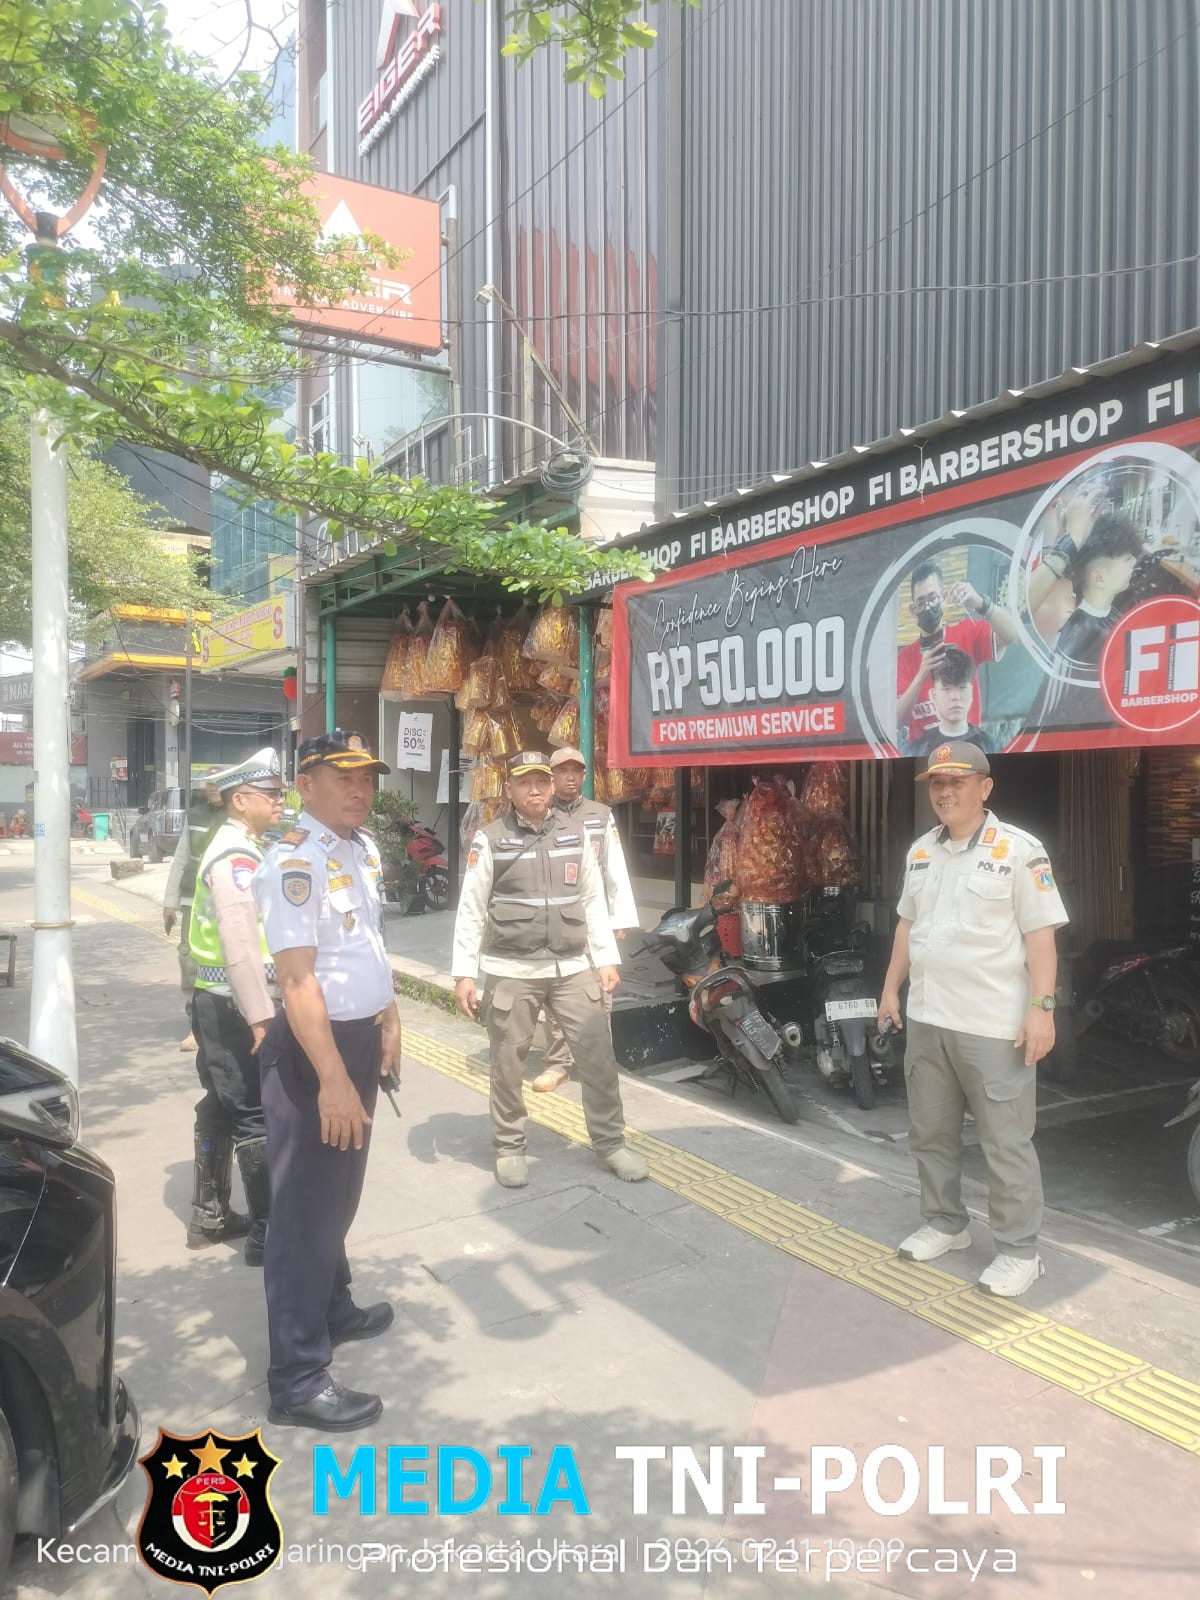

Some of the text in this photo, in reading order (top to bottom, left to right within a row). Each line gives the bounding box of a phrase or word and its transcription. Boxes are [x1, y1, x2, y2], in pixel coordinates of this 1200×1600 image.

[358, 2, 440, 134] EIGER
[341, 299, 414, 322] ADVENTURE
[690, 532, 706, 559] FI
[711, 486, 855, 552] BARBERSHOP
[869, 472, 892, 506] FI
[900, 399, 1123, 492] BARBERSHOP
[1147, 378, 1184, 424] FI
[653, 544, 842, 651] Confidence Begins Here
[1121, 692, 1198, 708] BARBERSHOP
[659, 707, 835, 742] FOR PREMIUM SERVICE
[403, 737, 426, 750] 50%
[998, 866, 1011, 876] PP
